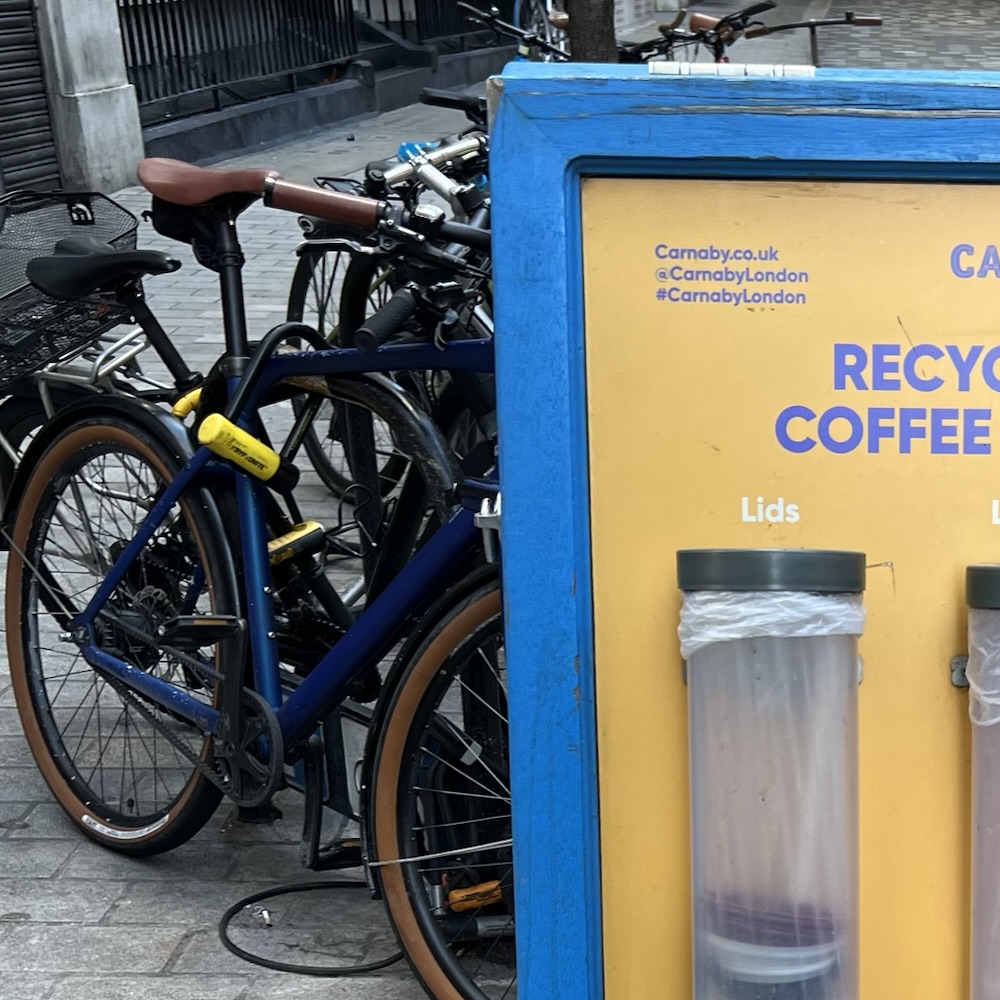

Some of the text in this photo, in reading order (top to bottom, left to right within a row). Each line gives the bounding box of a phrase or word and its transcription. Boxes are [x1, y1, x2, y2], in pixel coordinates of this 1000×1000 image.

[655, 244, 779, 264] Carnaby.co.uk
[655, 265, 809, 285] @CarnabyLondon
[656, 287, 806, 307] #CarnabyLondon
[774, 405, 991, 455] COFFEE
[741, 496, 800, 523] Lids
